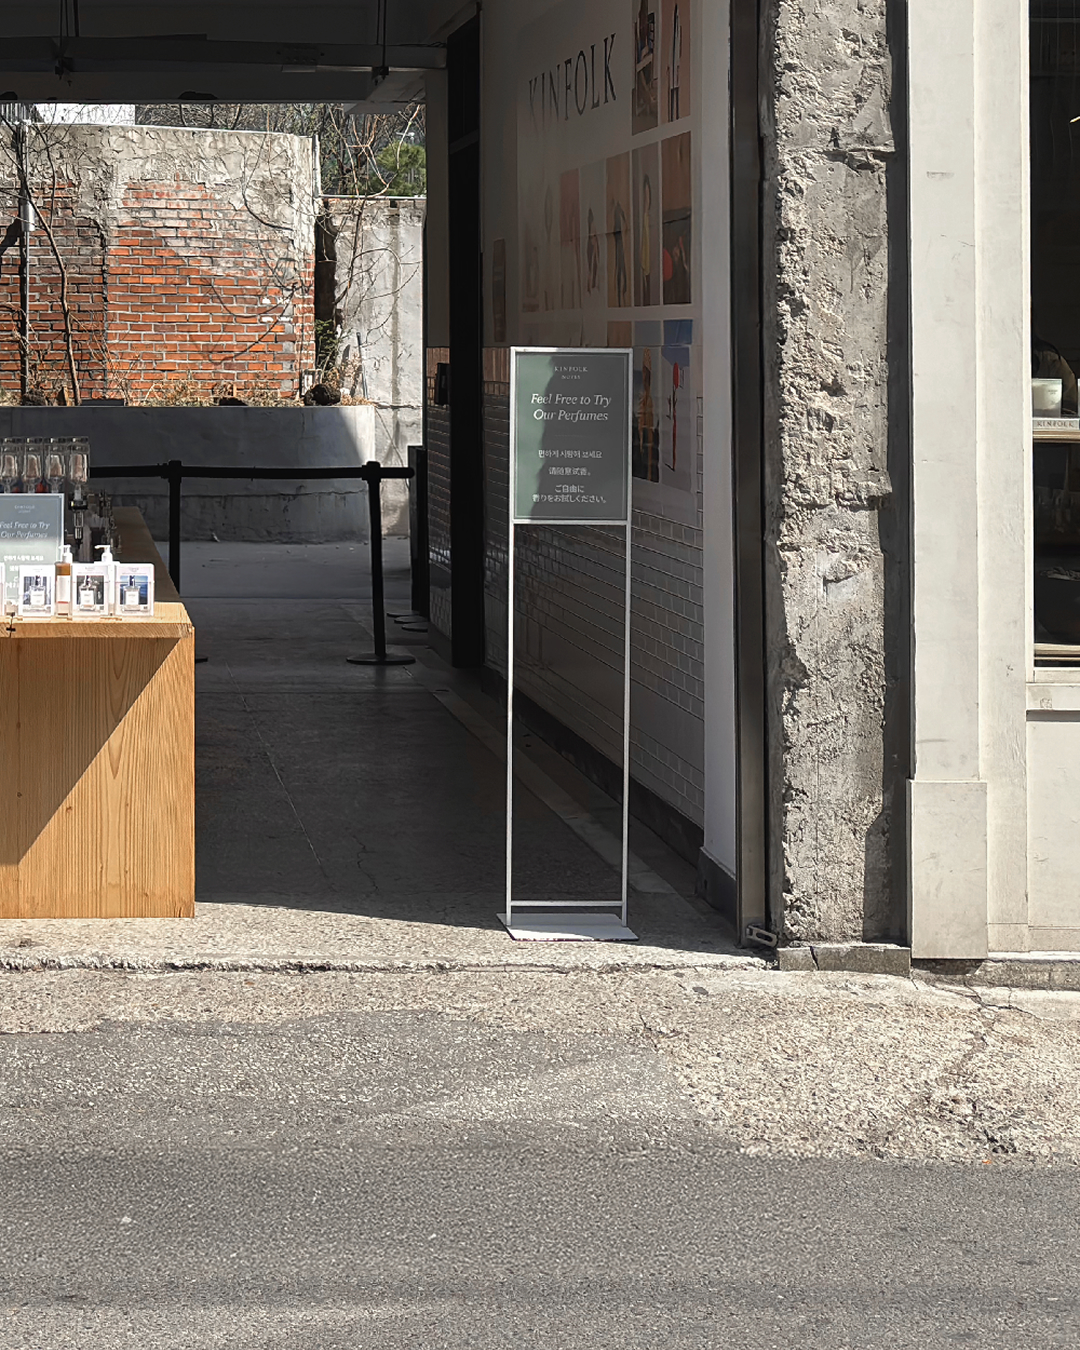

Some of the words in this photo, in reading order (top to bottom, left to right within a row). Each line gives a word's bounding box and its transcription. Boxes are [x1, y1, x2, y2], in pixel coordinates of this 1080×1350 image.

[529, 33, 616, 130] KINFOLK
[530, 393, 552, 405] Feel
[555, 393, 578, 406] Free
[580, 395, 591, 406] to
[593, 394, 612, 408] Try
[533, 408, 556, 421] Our
[557, 409, 609, 423] Perfumes
[0, 521, 13, 529] Feel
[39, 521, 51, 530] Try
